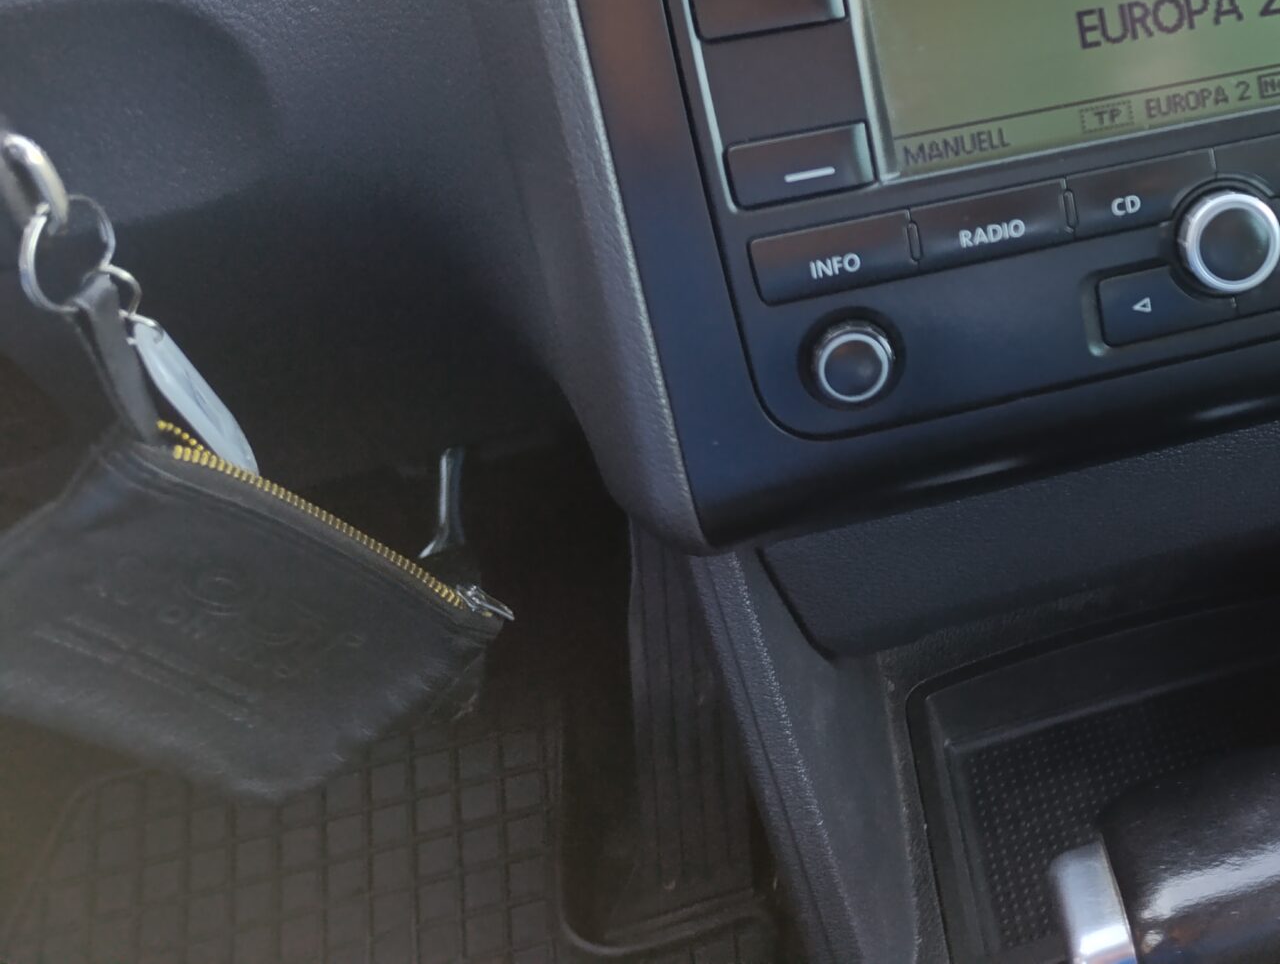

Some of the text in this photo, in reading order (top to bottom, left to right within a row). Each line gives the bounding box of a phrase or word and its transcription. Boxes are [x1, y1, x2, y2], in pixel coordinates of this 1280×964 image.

[1094, 108, 1122, 126] TP
[1145, 86, 1230, 119] EUROPA
[1235, 80, 1252, 102] 2
[903, 127, 1011, 166] MANUELL
[1110, 194, 1142, 216] CD
[958, 218, 1027, 249] RADIO
[808, 252, 862, 280] INFO
